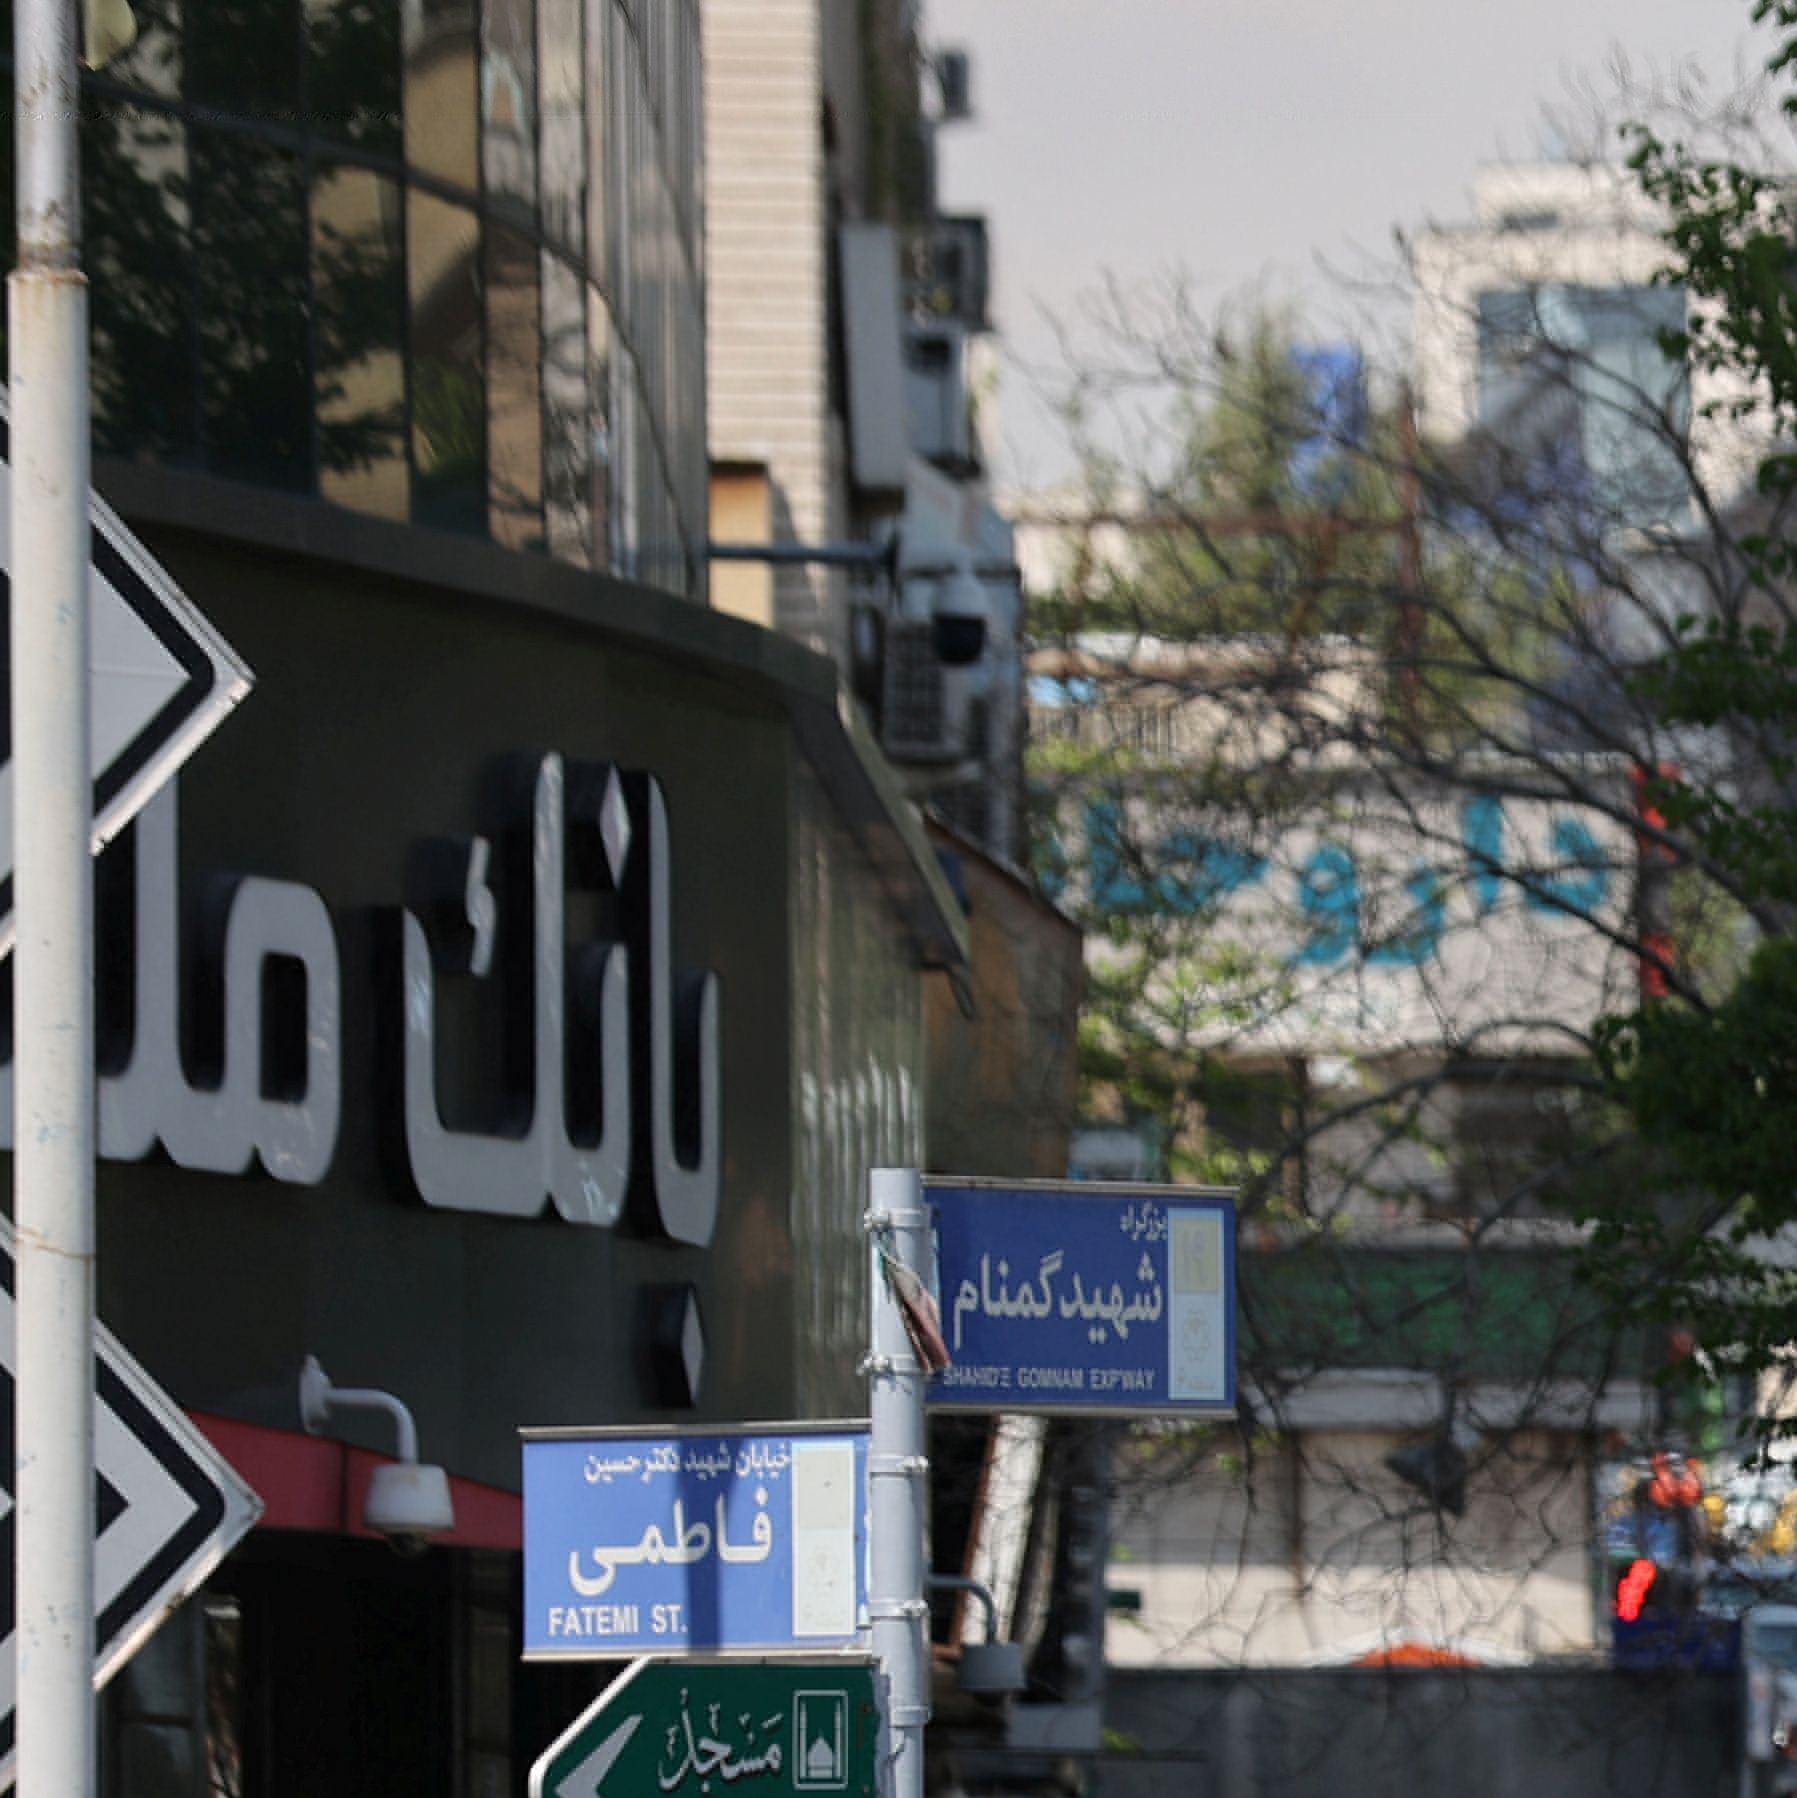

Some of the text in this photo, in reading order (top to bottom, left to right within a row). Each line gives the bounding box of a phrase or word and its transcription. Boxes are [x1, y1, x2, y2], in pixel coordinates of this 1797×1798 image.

[0, 765, 342, 1186] مل
[953, 1248, 1163, 1351] شهید گمنام
[584, 1455, 641, 1484] حسین
[684, 1441, 731, 1479] شهید
[735, 1442, 791, 1478] خیابان
[568, 1485, 773, 1597] فاطمی
[548, 1604, 688, 1636] FATEMI ST.
